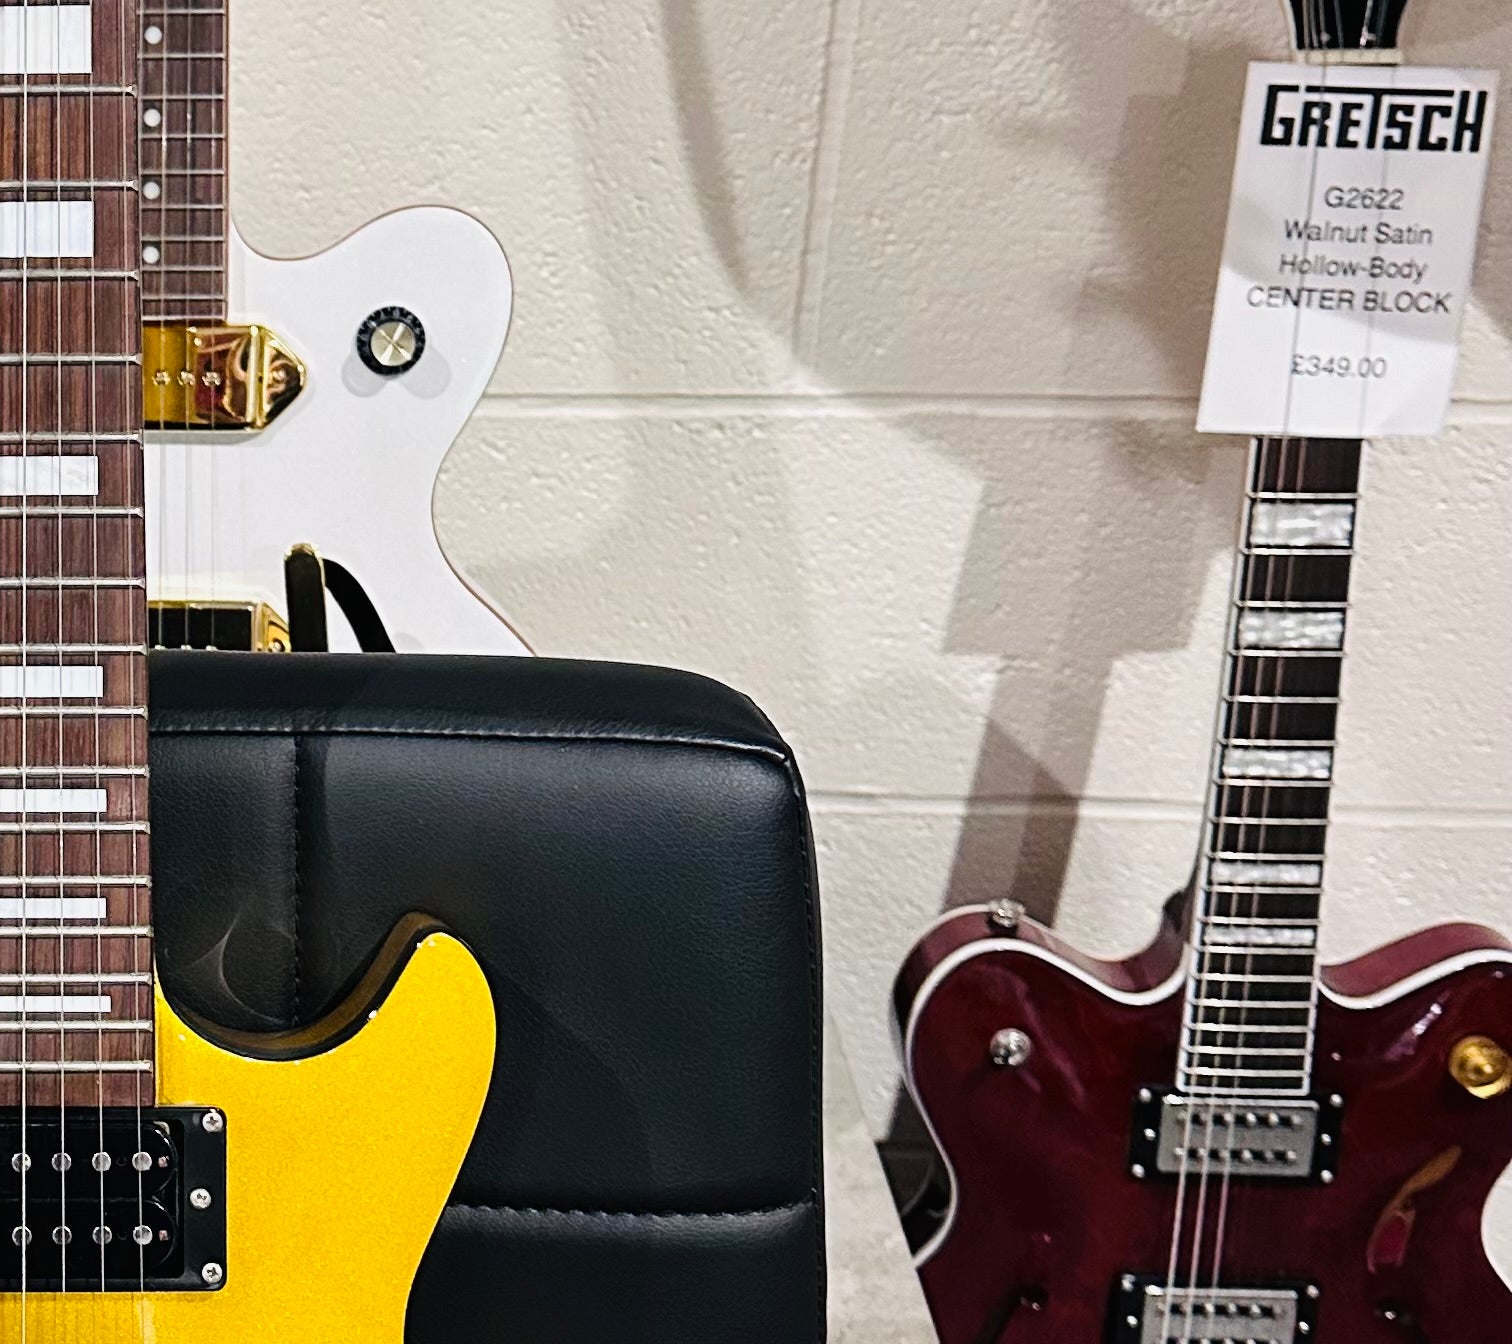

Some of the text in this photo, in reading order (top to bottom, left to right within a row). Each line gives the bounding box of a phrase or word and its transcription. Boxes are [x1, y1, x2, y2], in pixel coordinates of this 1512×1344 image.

[1259, 84, 1488, 153] GRETSCH
[1324, 185, 1405, 211] G2622
[1284, 218, 1434, 246] Walnut Satin
[1279, 253, 1428, 285] Hollow-Body
[1246, 285, 1453, 314] CENTER BLOCK
[1291, 353, 1387, 379] £349.00
